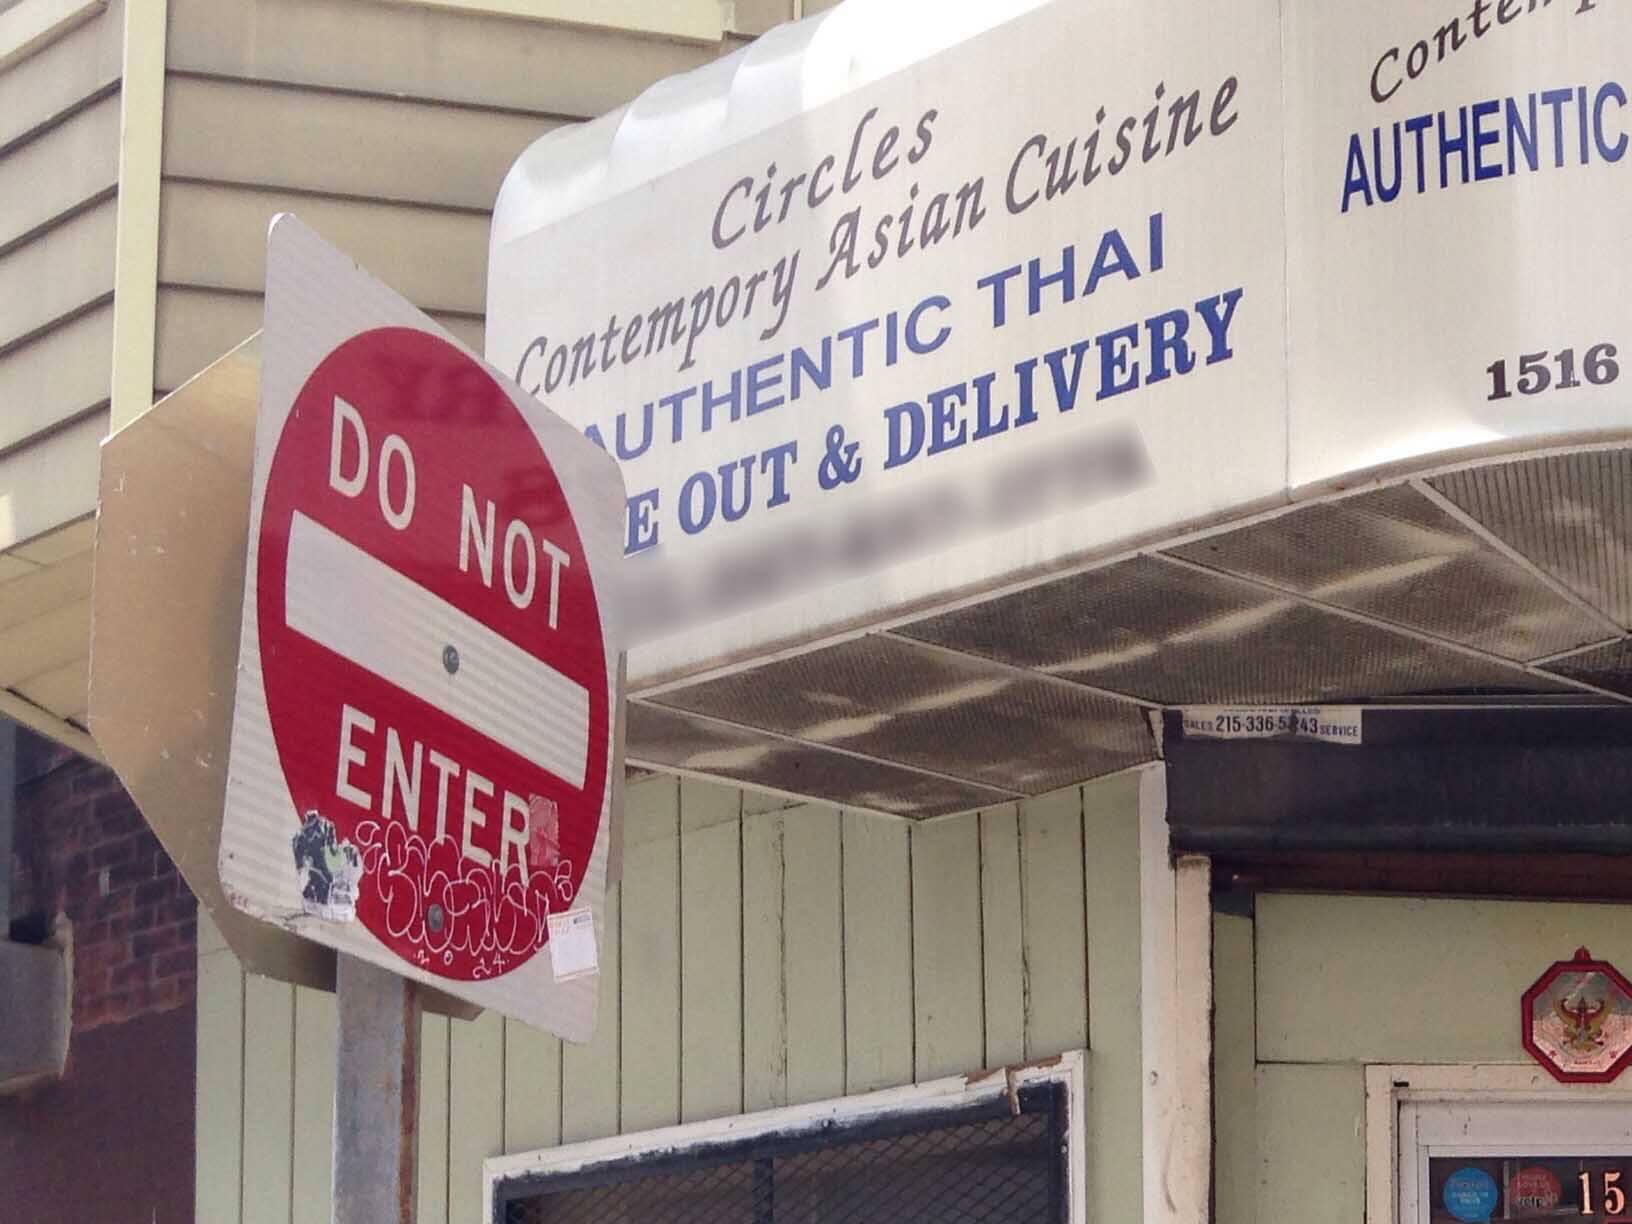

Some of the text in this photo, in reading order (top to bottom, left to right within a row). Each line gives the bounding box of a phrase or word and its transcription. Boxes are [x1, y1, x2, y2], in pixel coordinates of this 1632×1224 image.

[515, 75, 1239, 398] Contempory Asian Cuisine
[711, 107, 938, 251] Circles
[1339, 81, 1630, 214] AUTHENTIC
[584, 213, 1165, 461] UTHENTIC THAI
[678, 443, 798, 536] OUT
[817, 425, 863, 491] &
[883, 288, 1244, 470] DELIVERY
[1484, 343, 1620, 401] 1516
[329, 395, 417, 530] DO
[458, 484, 570, 630] NOT
[335, 703, 531, 888] ENTER
[1319, 726, 1359, 737] SERVICE
